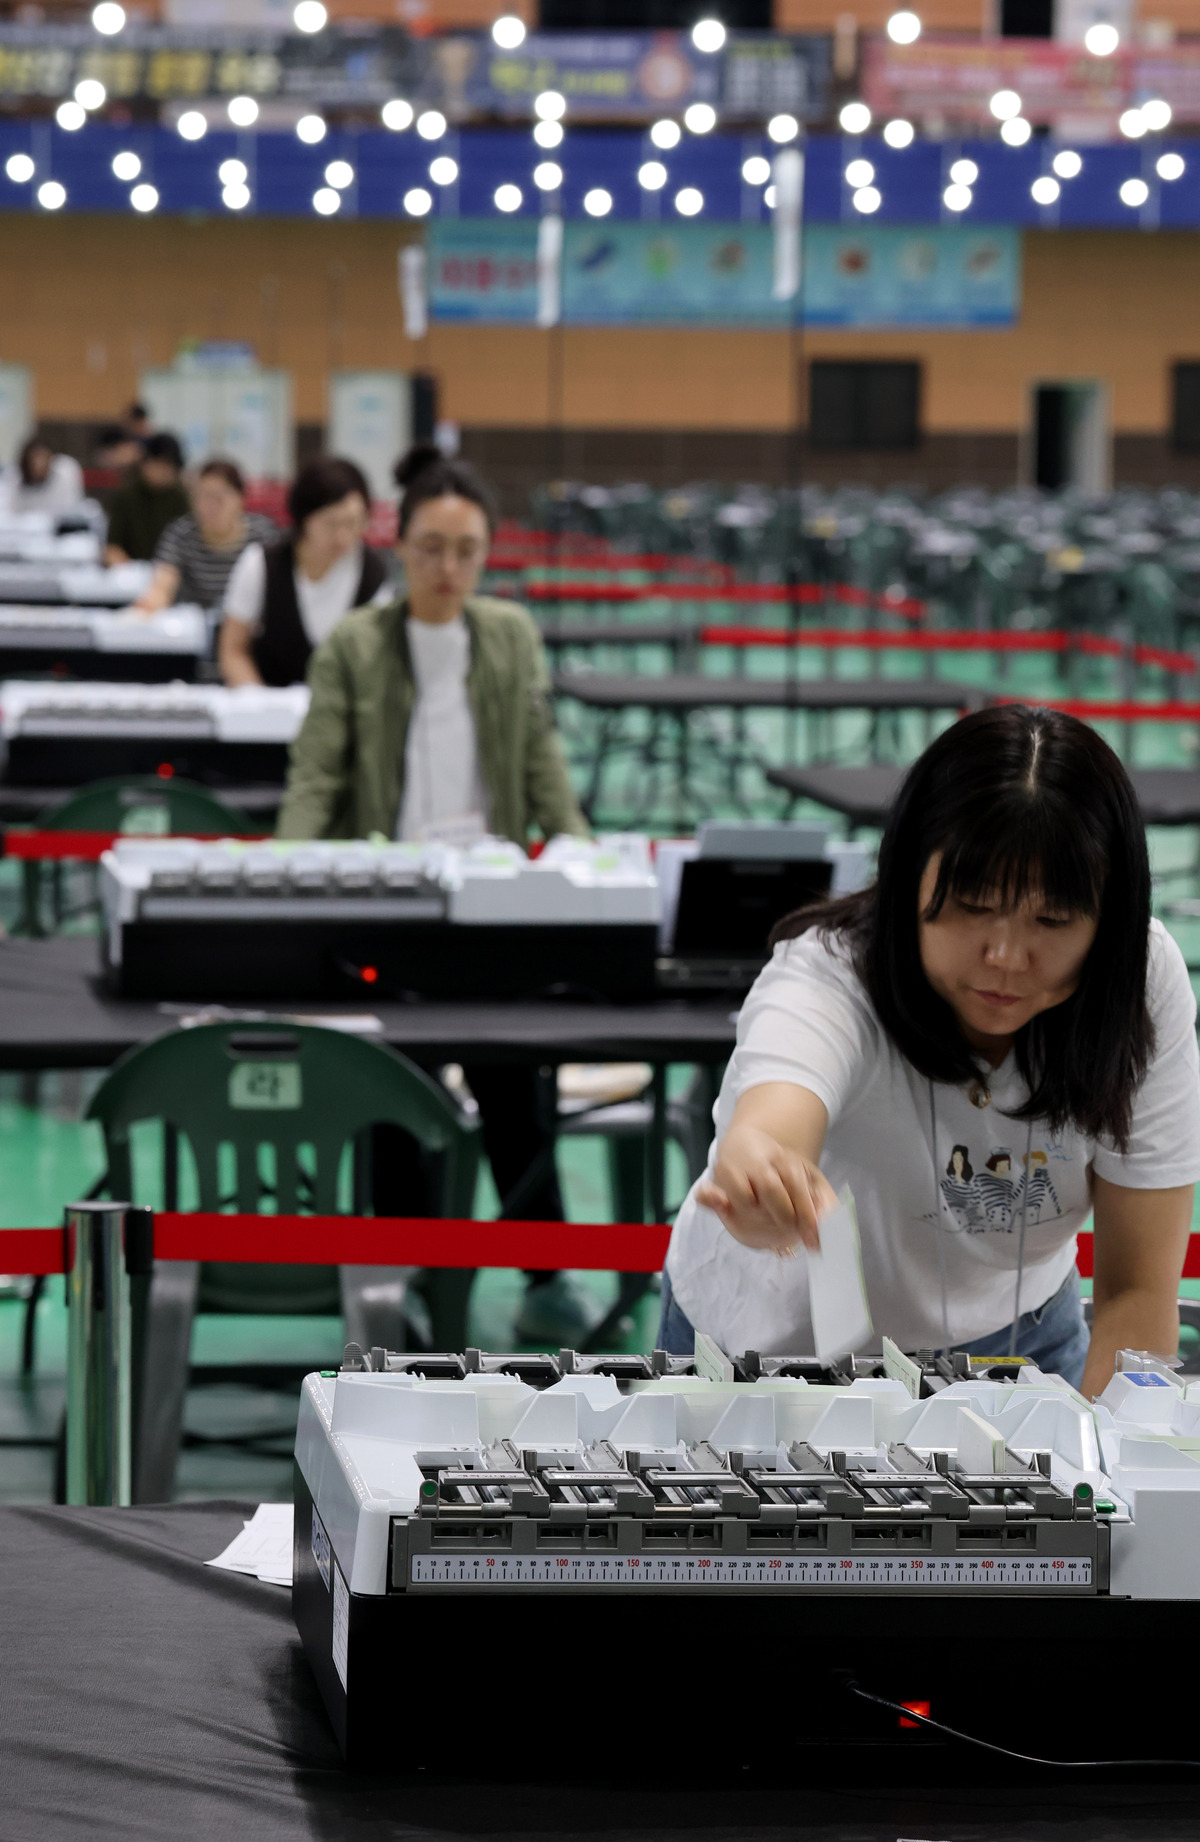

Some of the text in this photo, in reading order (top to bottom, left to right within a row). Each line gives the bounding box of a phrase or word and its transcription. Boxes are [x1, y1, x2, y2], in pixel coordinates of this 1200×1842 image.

[486, 1559, 495, 1567] 50
[555, 1559, 568, 1567] 100
[626, 1559, 639, 1567] 150
[769, 1560, 781, 1568] 250
[840, 1560, 852, 1568] 300
[910, 1560, 923, 1568] 350
[1052, 1561, 1065, 1569] 450
